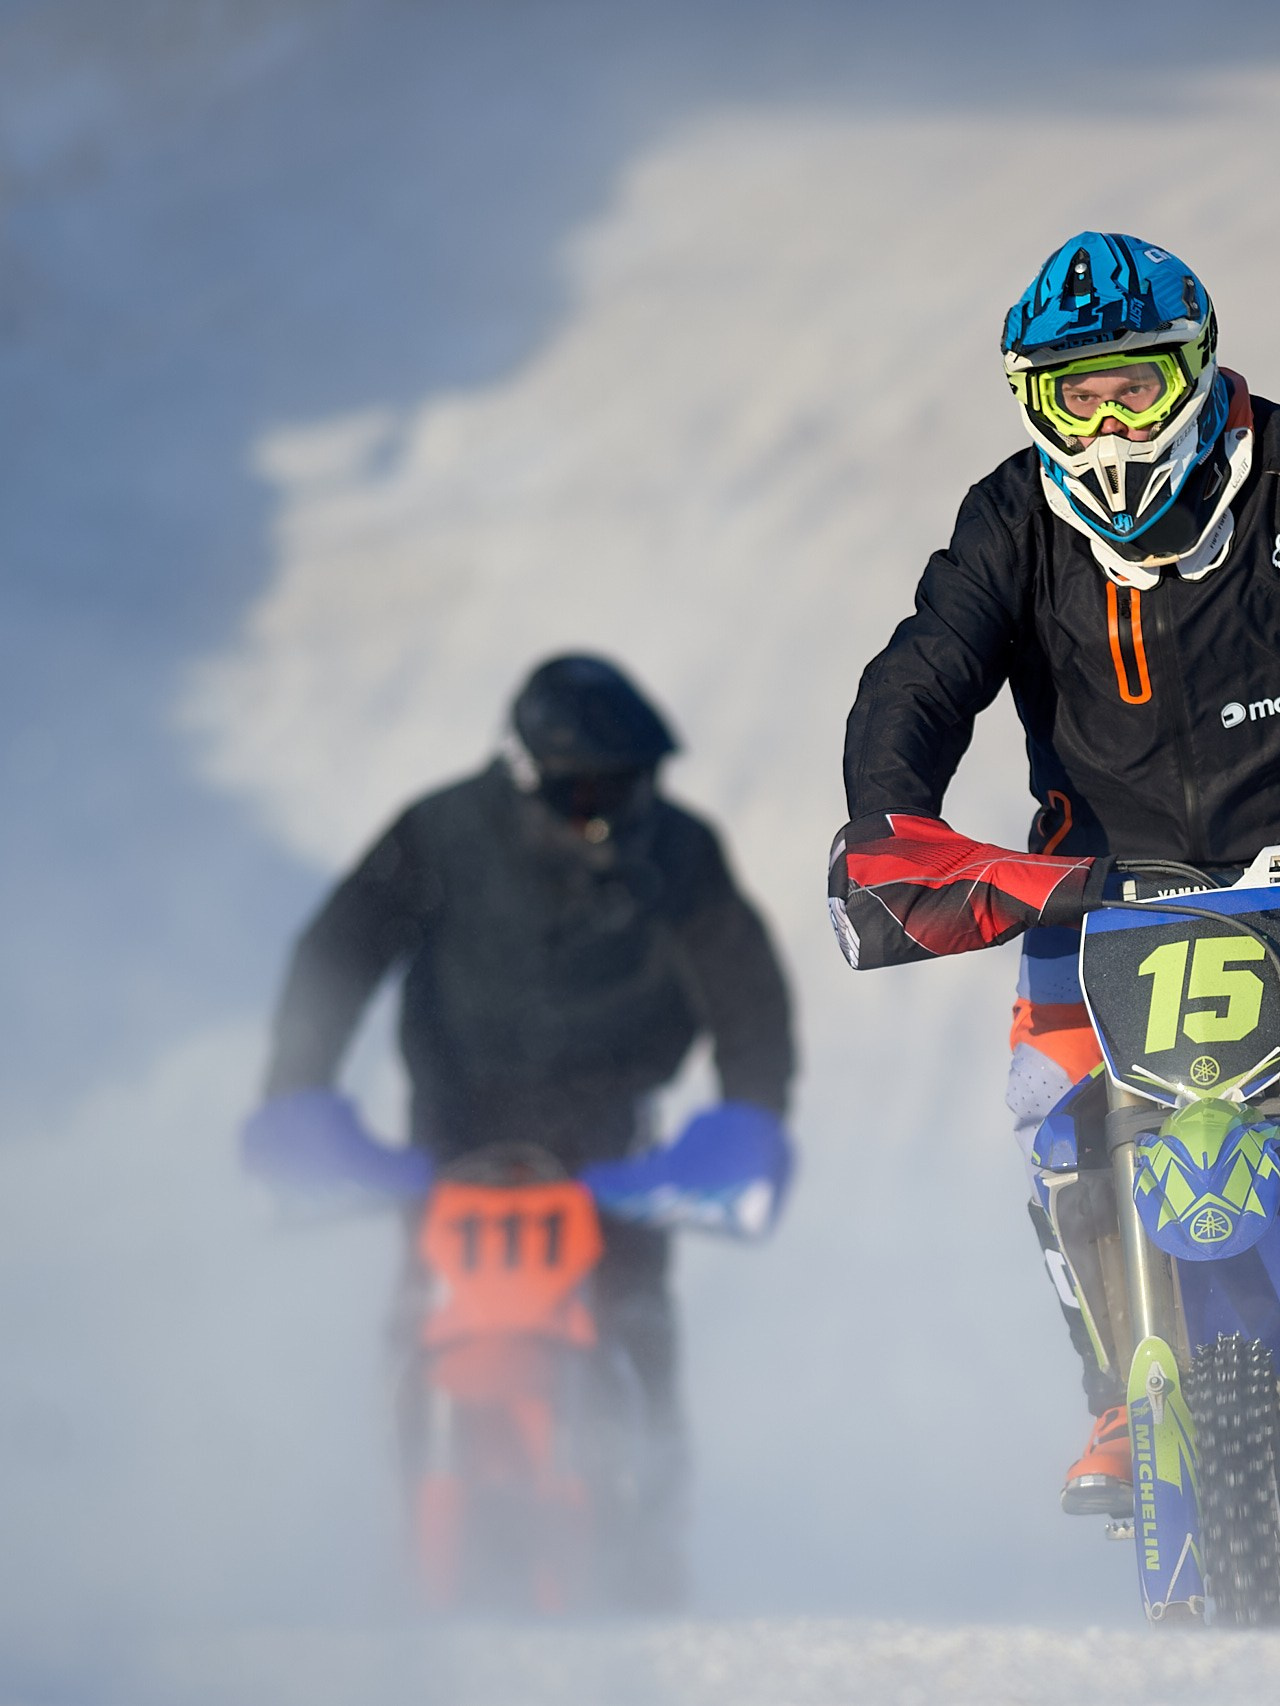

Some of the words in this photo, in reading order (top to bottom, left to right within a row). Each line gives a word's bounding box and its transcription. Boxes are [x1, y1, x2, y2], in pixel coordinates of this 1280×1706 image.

[1138, 936, 1266, 1054] 15
[450, 1210, 567, 1273] 111
[1135, 1424, 1161, 1571] MICHELIN
